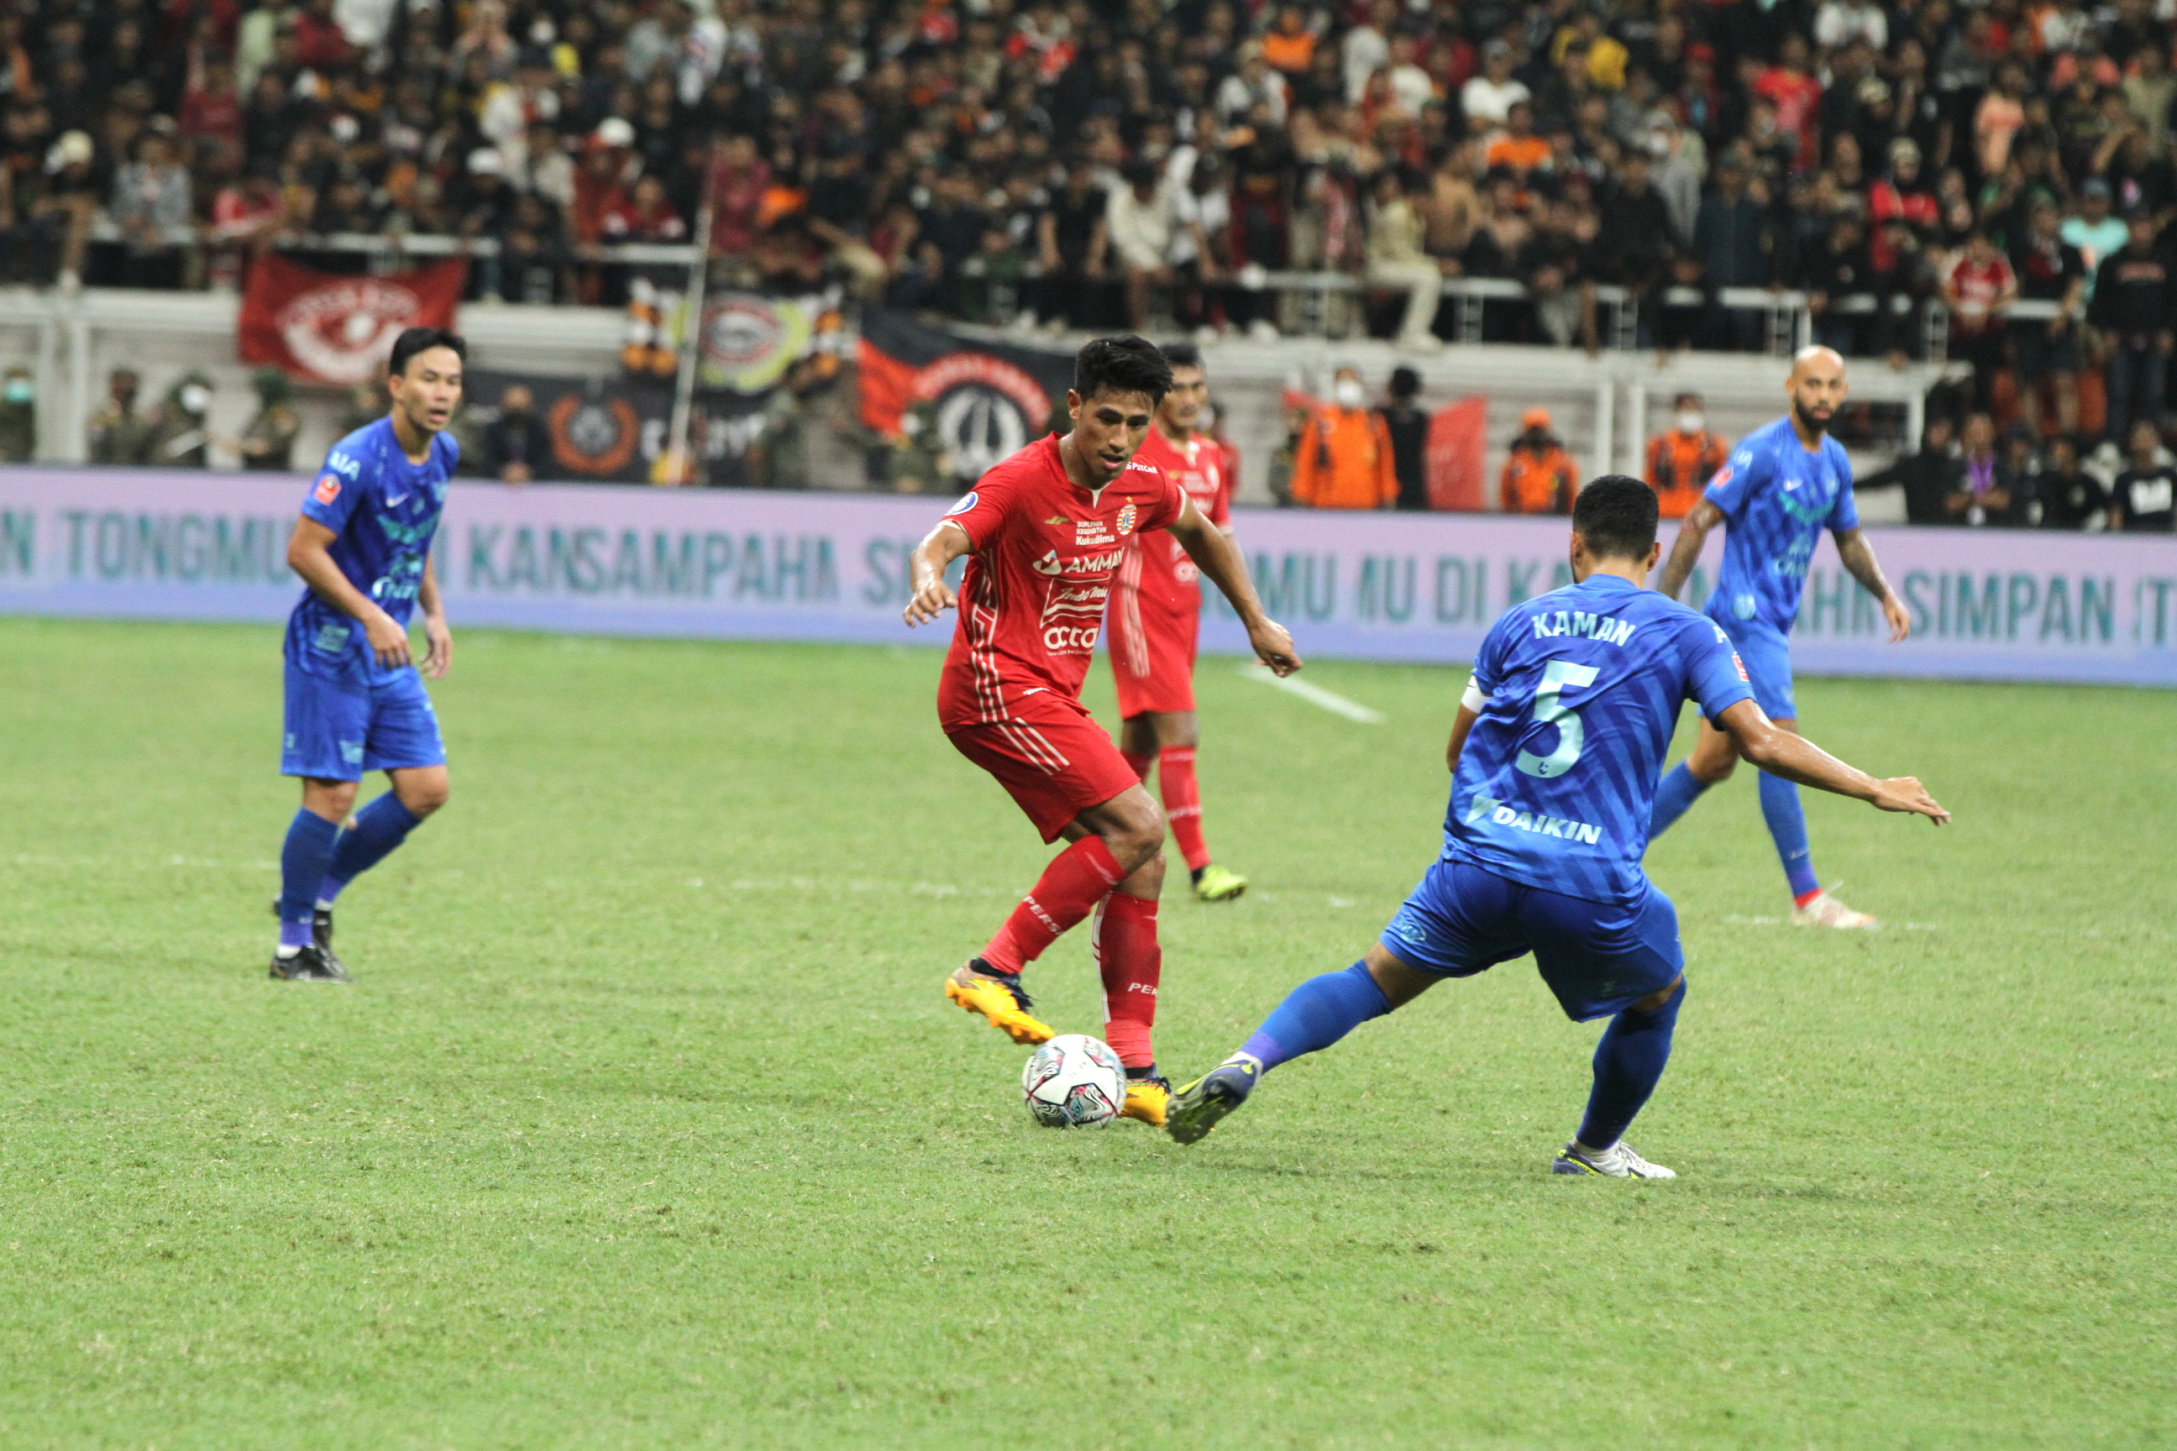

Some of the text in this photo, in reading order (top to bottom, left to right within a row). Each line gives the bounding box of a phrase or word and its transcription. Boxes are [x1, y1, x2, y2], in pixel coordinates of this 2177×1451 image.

[1532, 609, 1637, 647] KAMAN
[1902, 568, 2116, 644] SIMPAN
[1515, 660, 1600, 778] 5
[1492, 805, 1602, 845] DAIKIN
